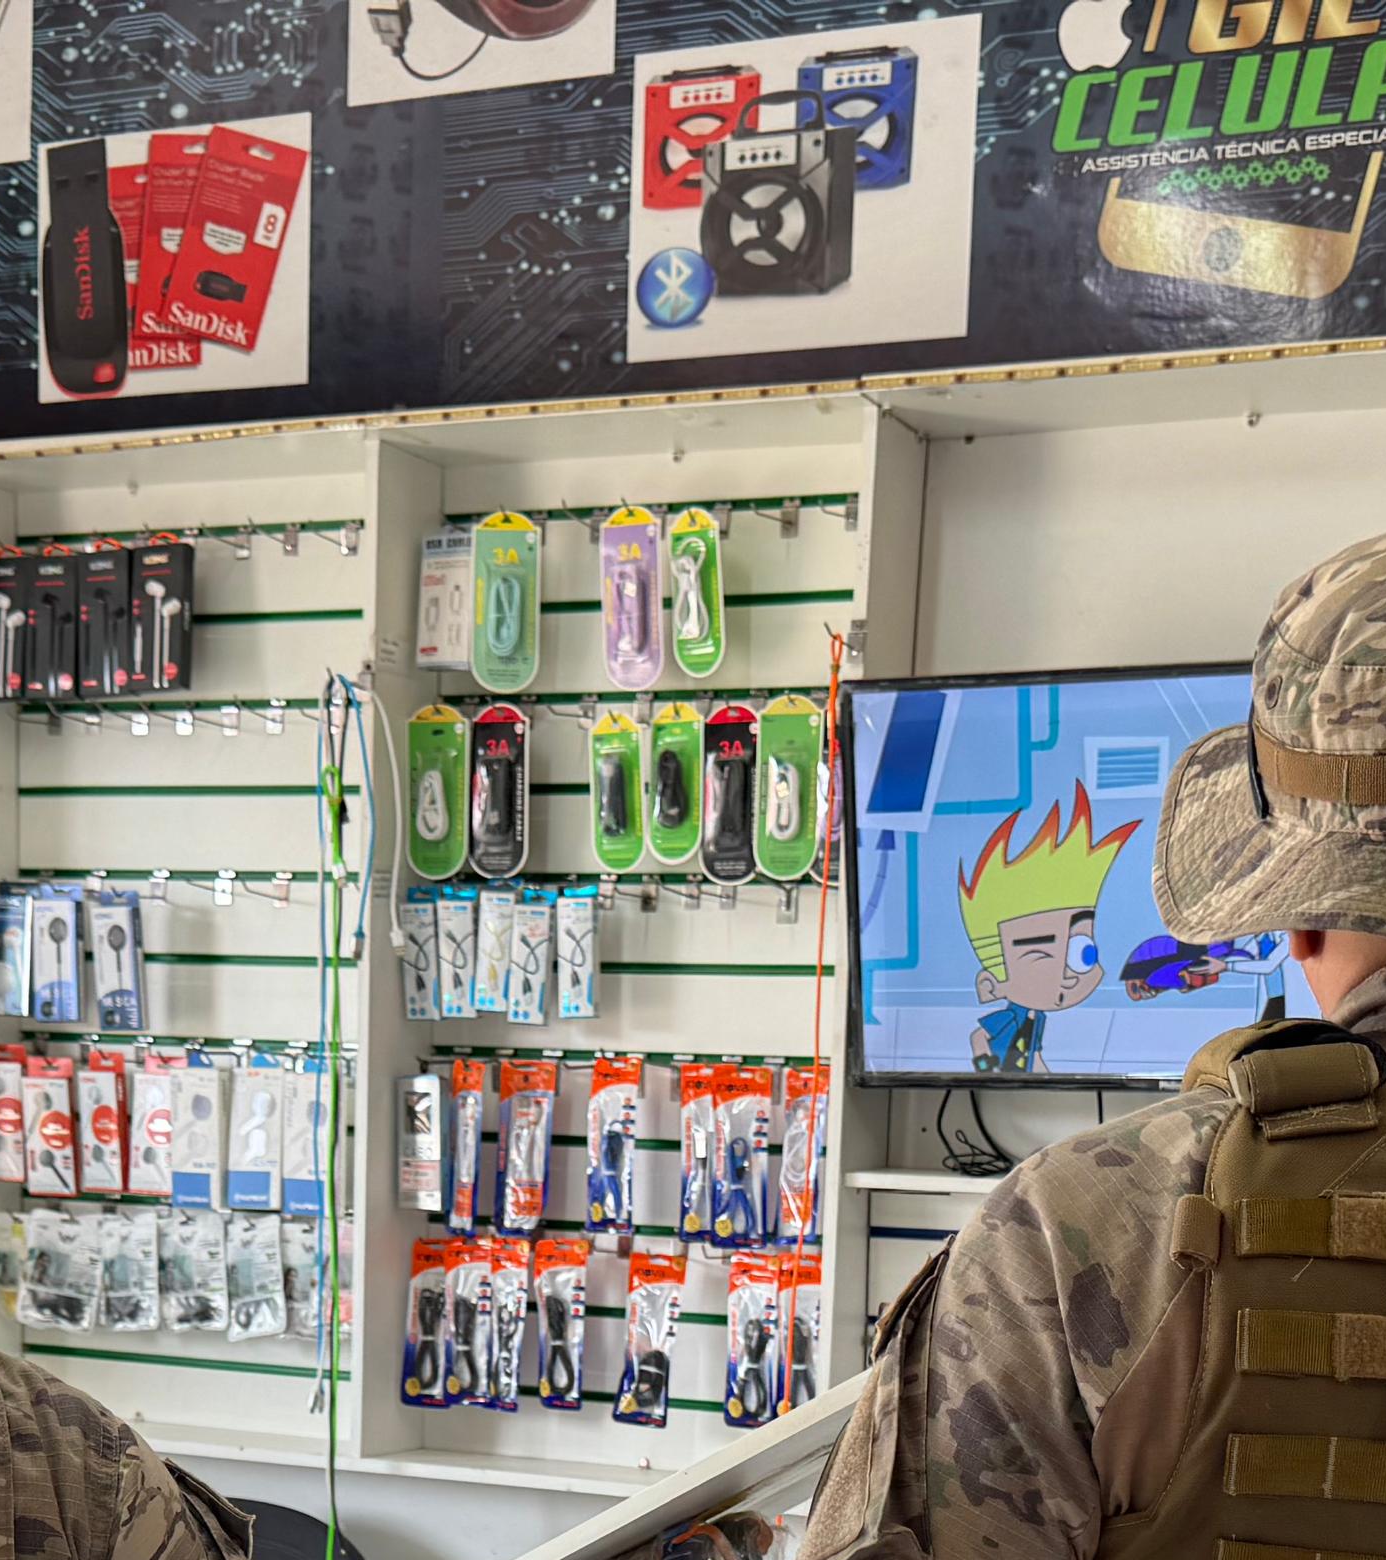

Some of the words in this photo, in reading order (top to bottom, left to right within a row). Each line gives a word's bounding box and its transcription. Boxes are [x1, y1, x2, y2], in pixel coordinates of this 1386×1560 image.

[1213, 134, 1302, 160] TÉCNICA
[73, 226, 94, 321] SanDisk
[168, 301, 250, 347] SanDisk
[485, 739, 511, 757] 3A
[718, 740, 744, 758] 3A
